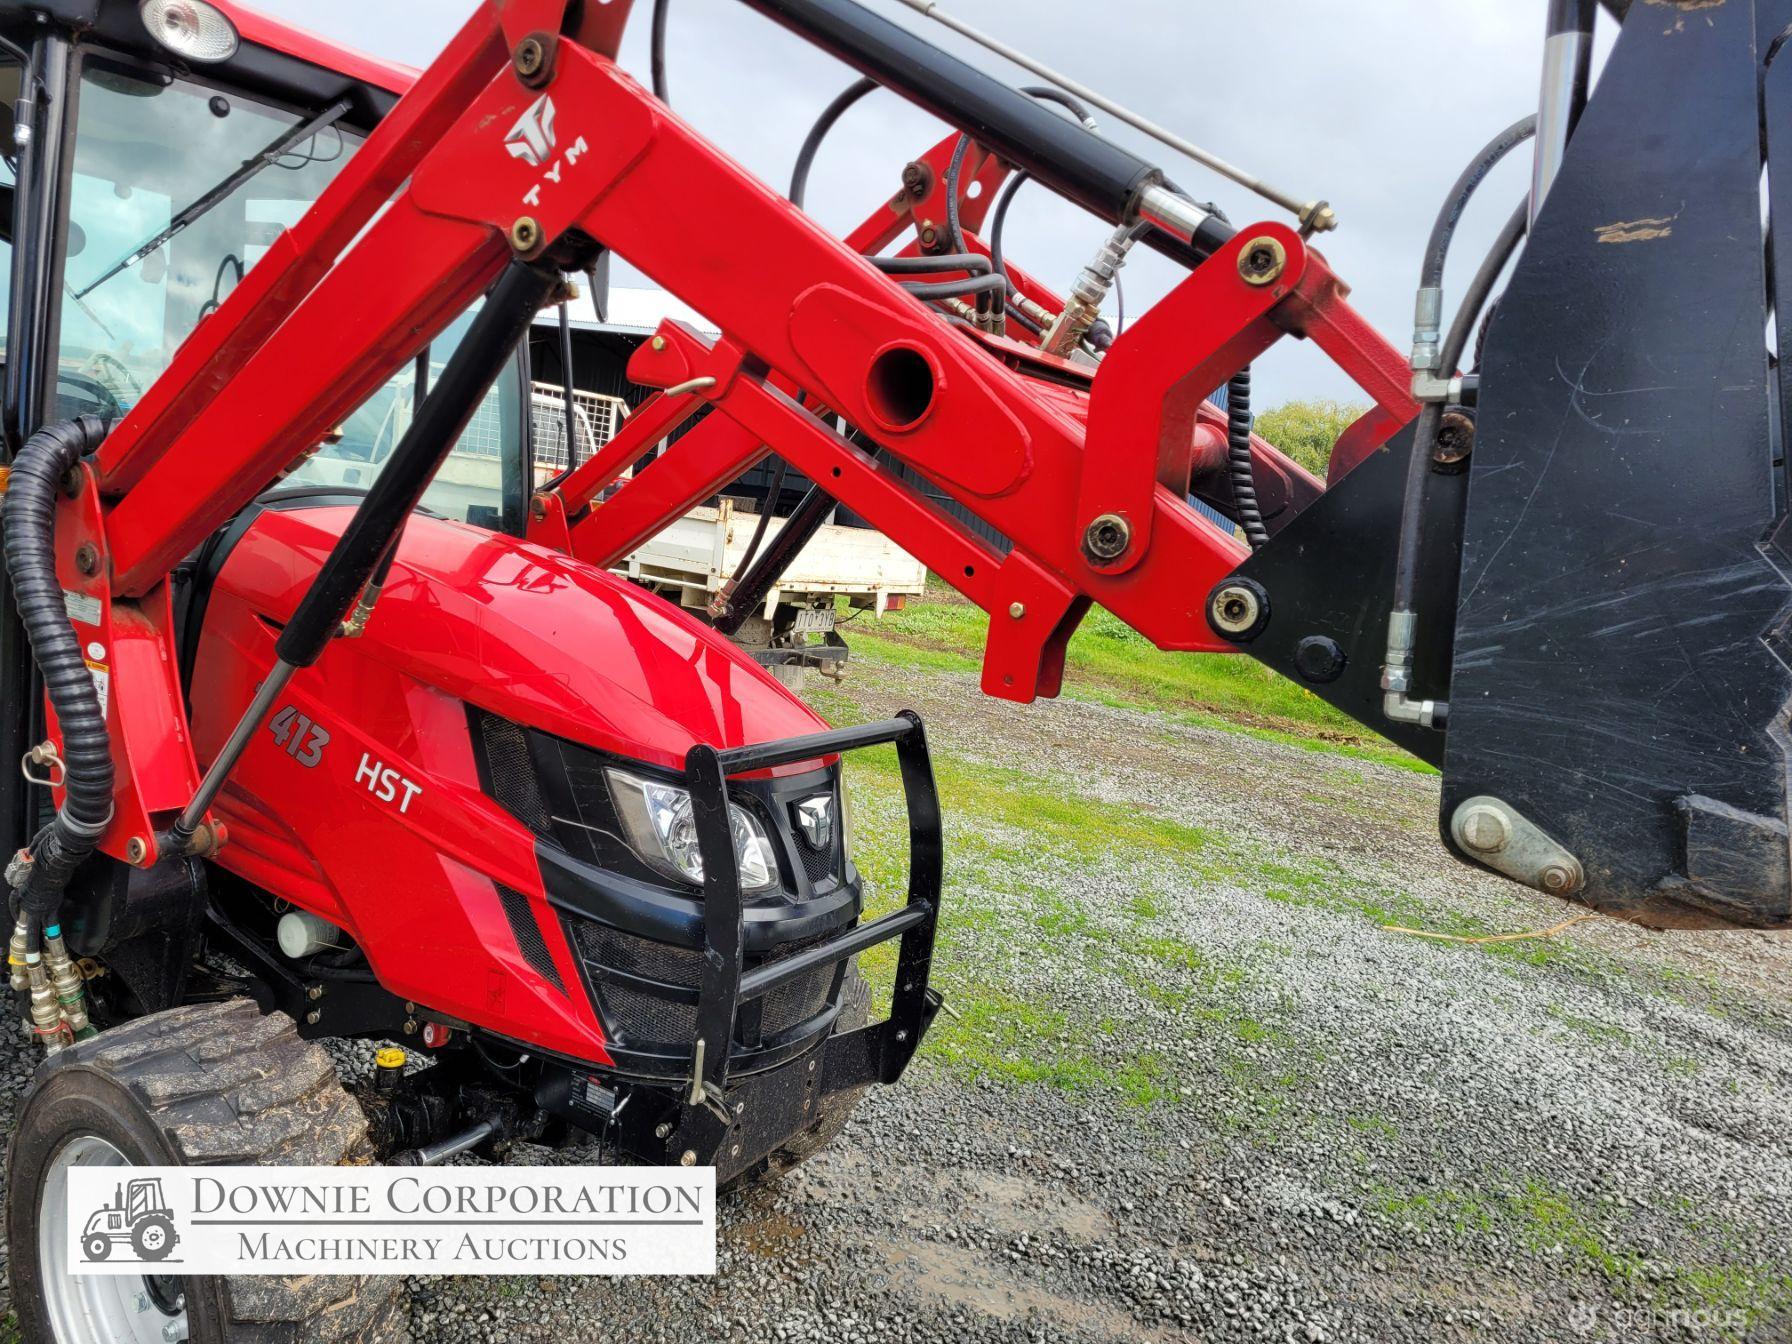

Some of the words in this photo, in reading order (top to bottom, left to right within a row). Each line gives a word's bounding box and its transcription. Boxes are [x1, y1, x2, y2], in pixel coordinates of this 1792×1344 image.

[522, 136, 588, 206] TYM
[268, 704, 331, 769] 413
[354, 752, 423, 814] HST
